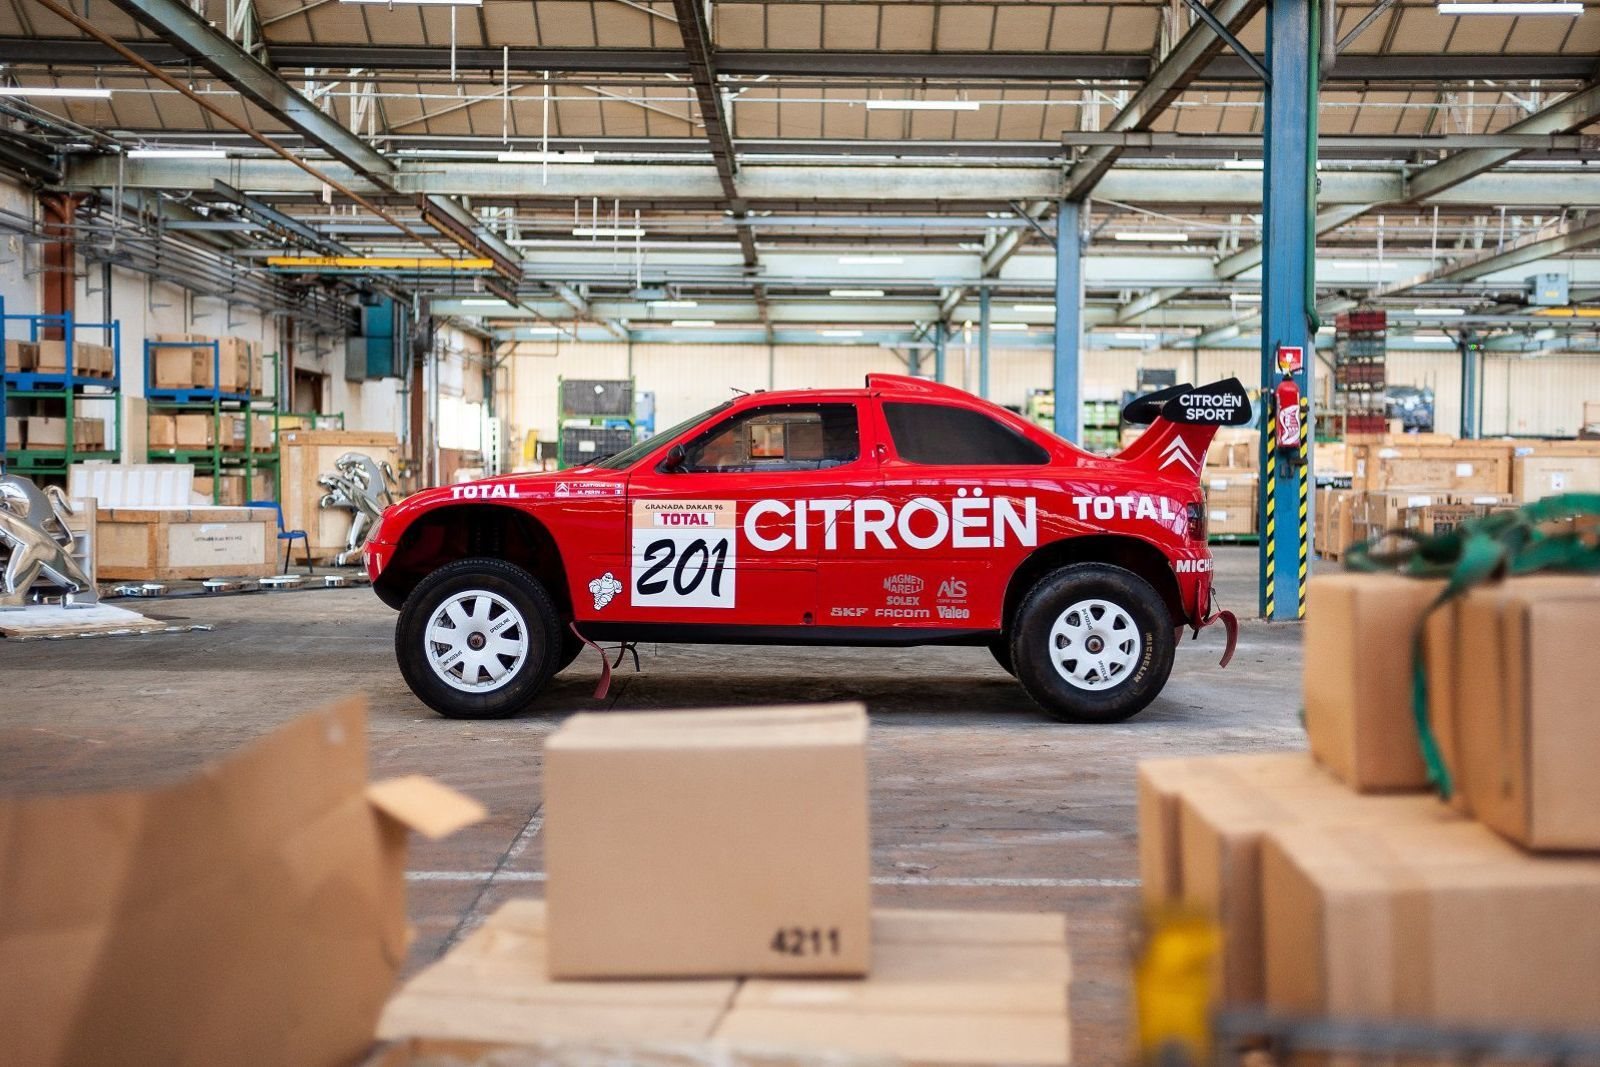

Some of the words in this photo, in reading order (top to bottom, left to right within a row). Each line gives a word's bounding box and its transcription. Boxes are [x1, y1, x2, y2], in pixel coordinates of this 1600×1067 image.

[1179, 392, 1242, 407] CITROËN
[1186, 408, 1234, 421] SPORT
[451, 484, 520, 499] TOTAL
[1073, 496, 1176, 520] TOTAL
[661, 513, 709, 526] TOTAL
[744, 487, 1038, 551] CITROËN
[637, 537, 728, 597] 201
[886, 596, 920, 606] SOLEX
[831, 607, 869, 617] SKF
[936, 605, 970, 619] Valeo
[1133, 632, 1153, 683] MICHELIN
[769, 926, 840, 956] 4211
